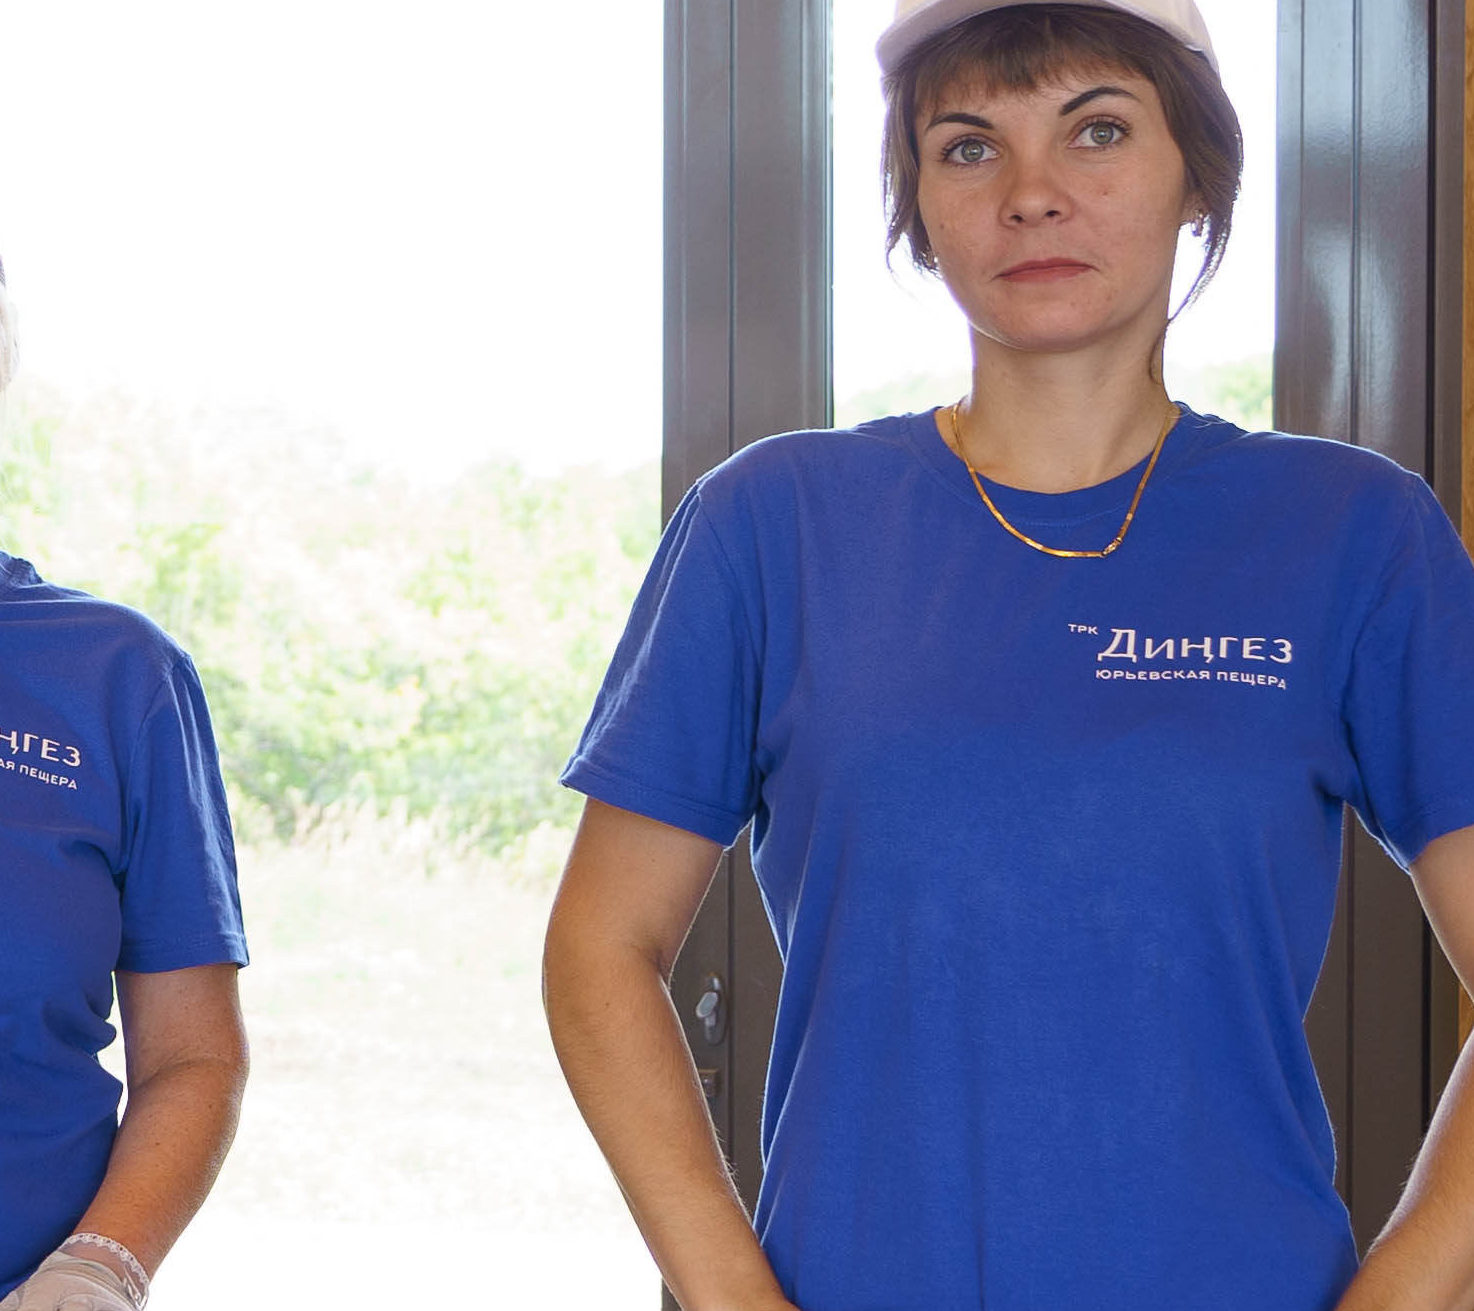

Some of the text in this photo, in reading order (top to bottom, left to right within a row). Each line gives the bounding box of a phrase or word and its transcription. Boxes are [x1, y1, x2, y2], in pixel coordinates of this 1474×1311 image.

[1068, 623, 1099, 635] ТРК
[1095, 669, 1287, 690] ЮРЬЕВСКАЯ ПЕЩЕРА
[19, 764, 78, 790] ПЕЩЕРА
